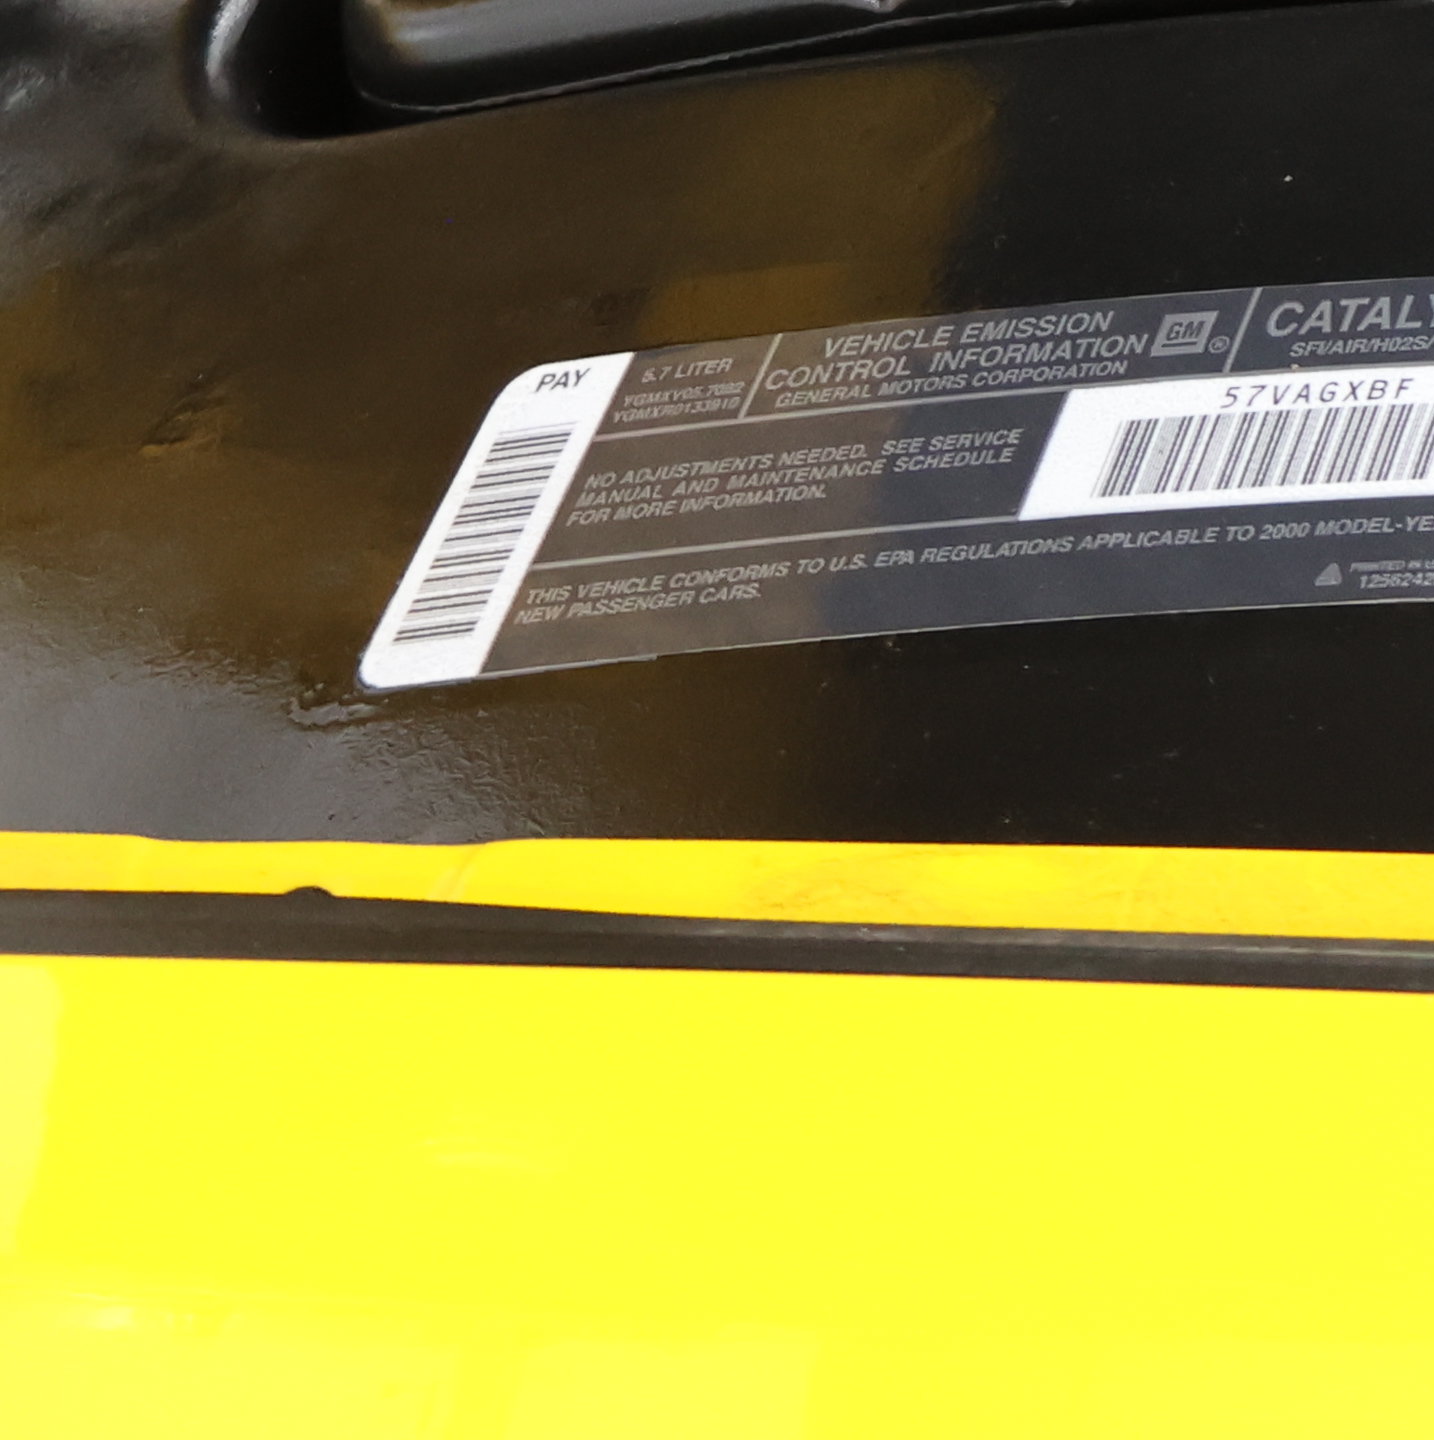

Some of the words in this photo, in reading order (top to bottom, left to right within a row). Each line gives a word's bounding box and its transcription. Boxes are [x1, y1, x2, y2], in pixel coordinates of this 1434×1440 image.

[824, 325, 955, 358] VEHICLE
[959, 310, 1114, 345] EMISSION
[535, 366, 590, 392] PAY
[642, 366, 670, 382] 5.7
[675, 358, 733, 377] LITER
[765, 356, 909, 391] CONTROL
[929, 334, 1148, 372] INFORMATION
[774, 383, 872, 409] GENERAL
[879, 373, 966, 397] MOTORS
[972, 359, 1128, 388] CORPORATION
[1221, 378, 1415, 408] 57VAGXBF
[576, 484, 662, 507] MANUAL
[673, 478, 718, 496] AND
[727, 460, 885, 490] MAINTENANCE
[893, 447, 1016, 472] SCHEDULE
[585, 473, 616, 490] NO
[620, 454, 773, 484] ADJUSTMENTS
[777, 444, 868, 466] NEEDED.
[882, 439, 925, 455] SEE
[928, 429, 1024, 451] SERVICE
[568, 507, 609, 526] FOR
[614, 502, 675, 520] MORE
[680, 484, 827, 514] INFORMATION.
[527, 586, 571, 605] THIS
[577, 574, 664, 599] VEHICLE
[670, 563, 788, 588] CONFORMS
[797, 557, 825, 575] TO
[830, 553, 867, 572] U.S.
[874, 548, 915, 568] EPA
[921, 535, 1072, 564] REGULATIONS
[1077, 527, 1217, 553] APPLICABLE
[1226, 525, 1256, 541] TO
[1260, 521, 1310, 540] 2000
[515, 606, 563, 624] NEW
[566, 589, 701, 619] PASSENGER
[700, 583, 761, 603] CARS.
